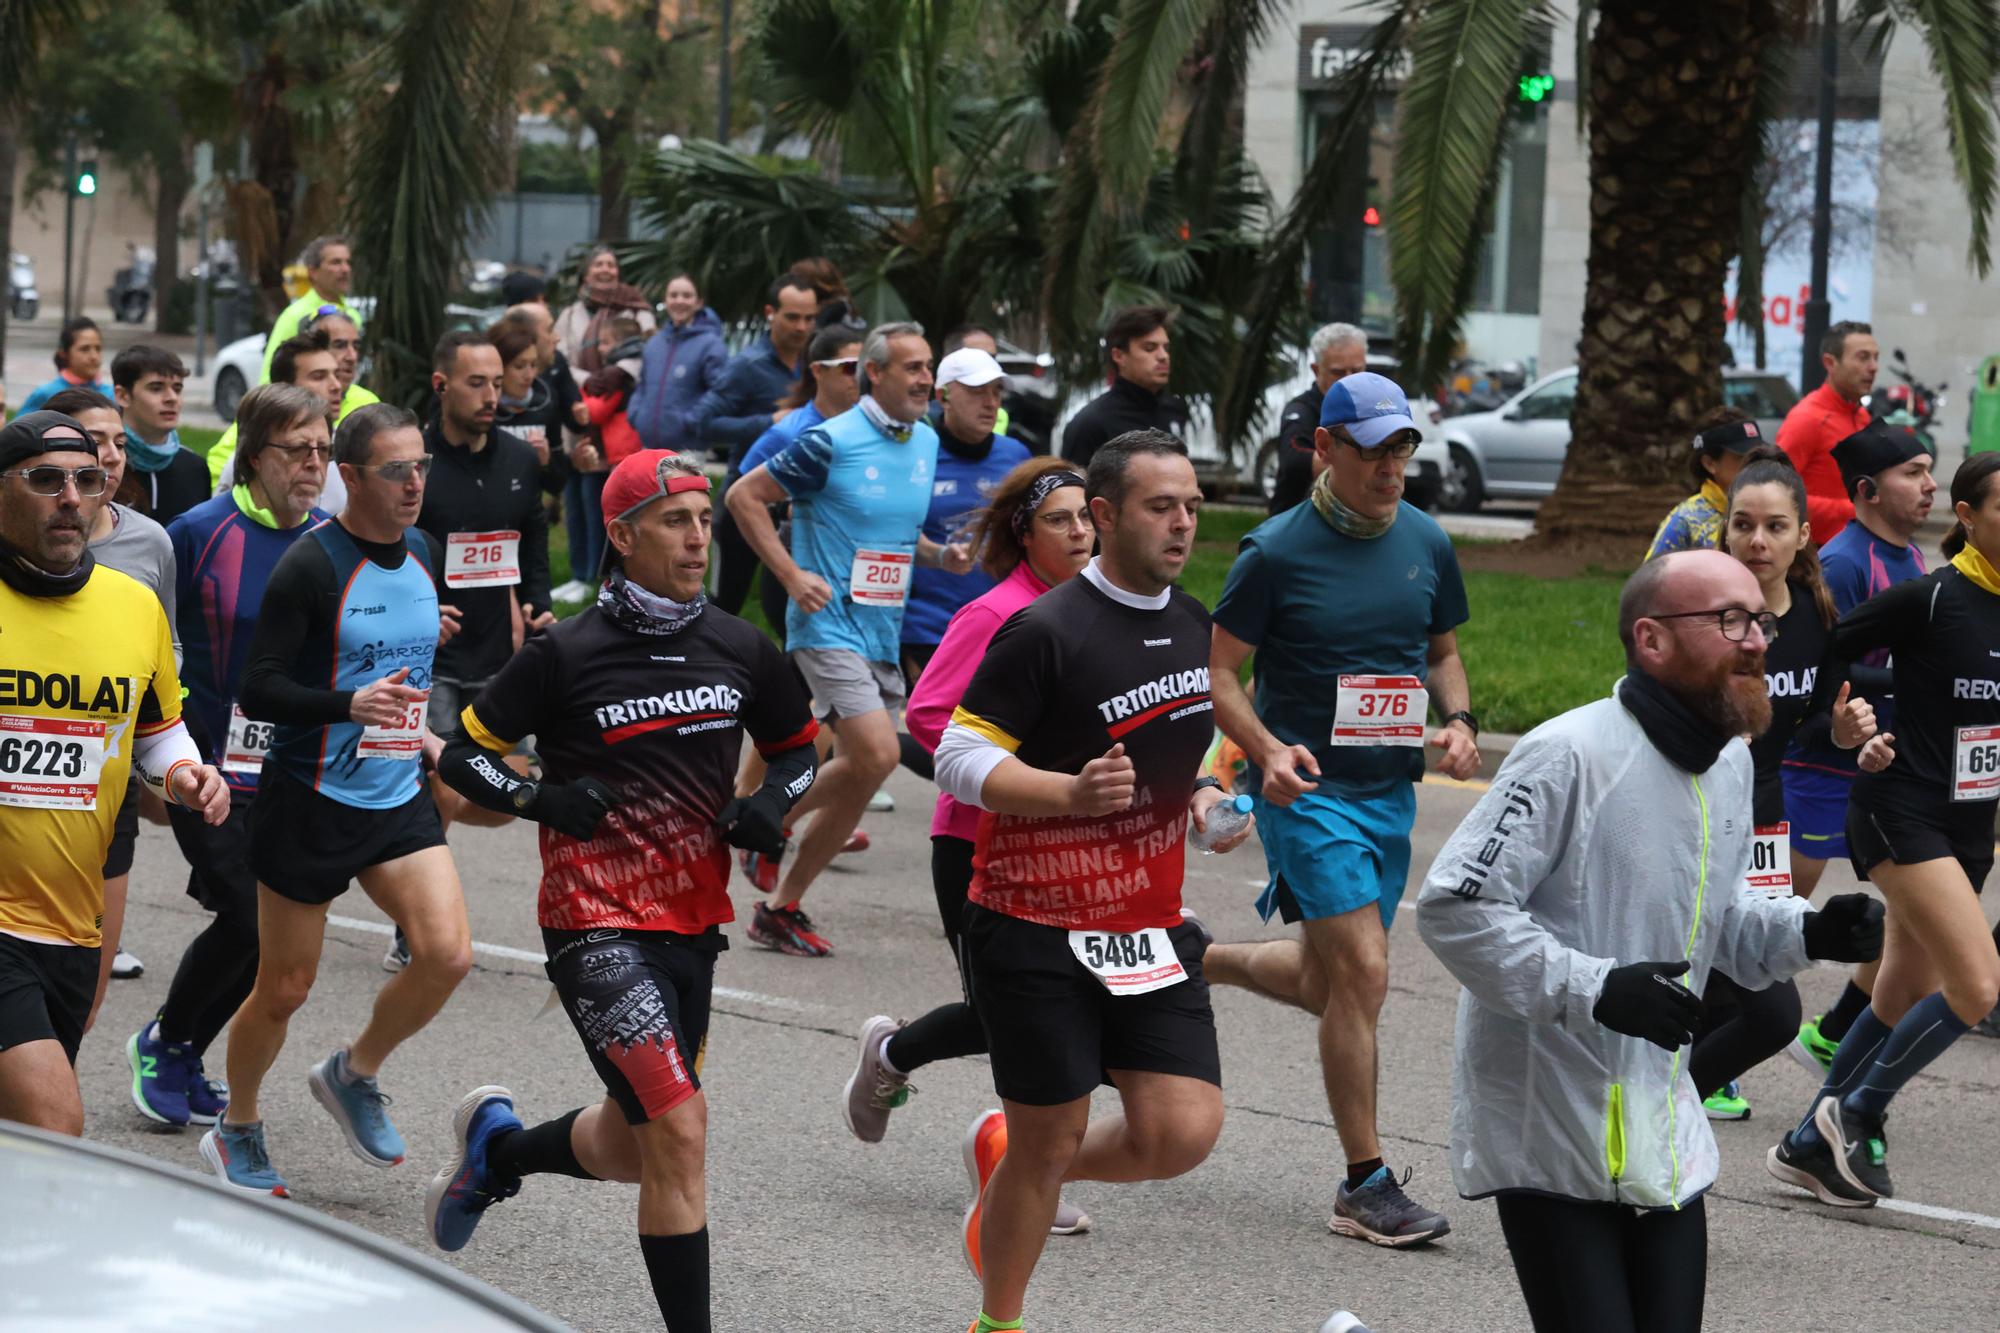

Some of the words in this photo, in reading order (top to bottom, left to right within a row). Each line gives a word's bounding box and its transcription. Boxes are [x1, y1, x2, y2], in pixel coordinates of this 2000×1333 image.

[463, 545, 502, 564] 216
[866, 565, 900, 584] 203
[1358, 694, 1408, 716] 376
[0, 738, 83, 778] 6223
[1969, 745, 2000, 774] 65
[1034, 823, 1110, 846] RUNNING
[986, 844, 1123, 885] RUNNING
[1748, 841, 1776, 871] 01
[1025, 867, 1151, 911] MELIANA
[1085, 934, 1155, 968] 5484
